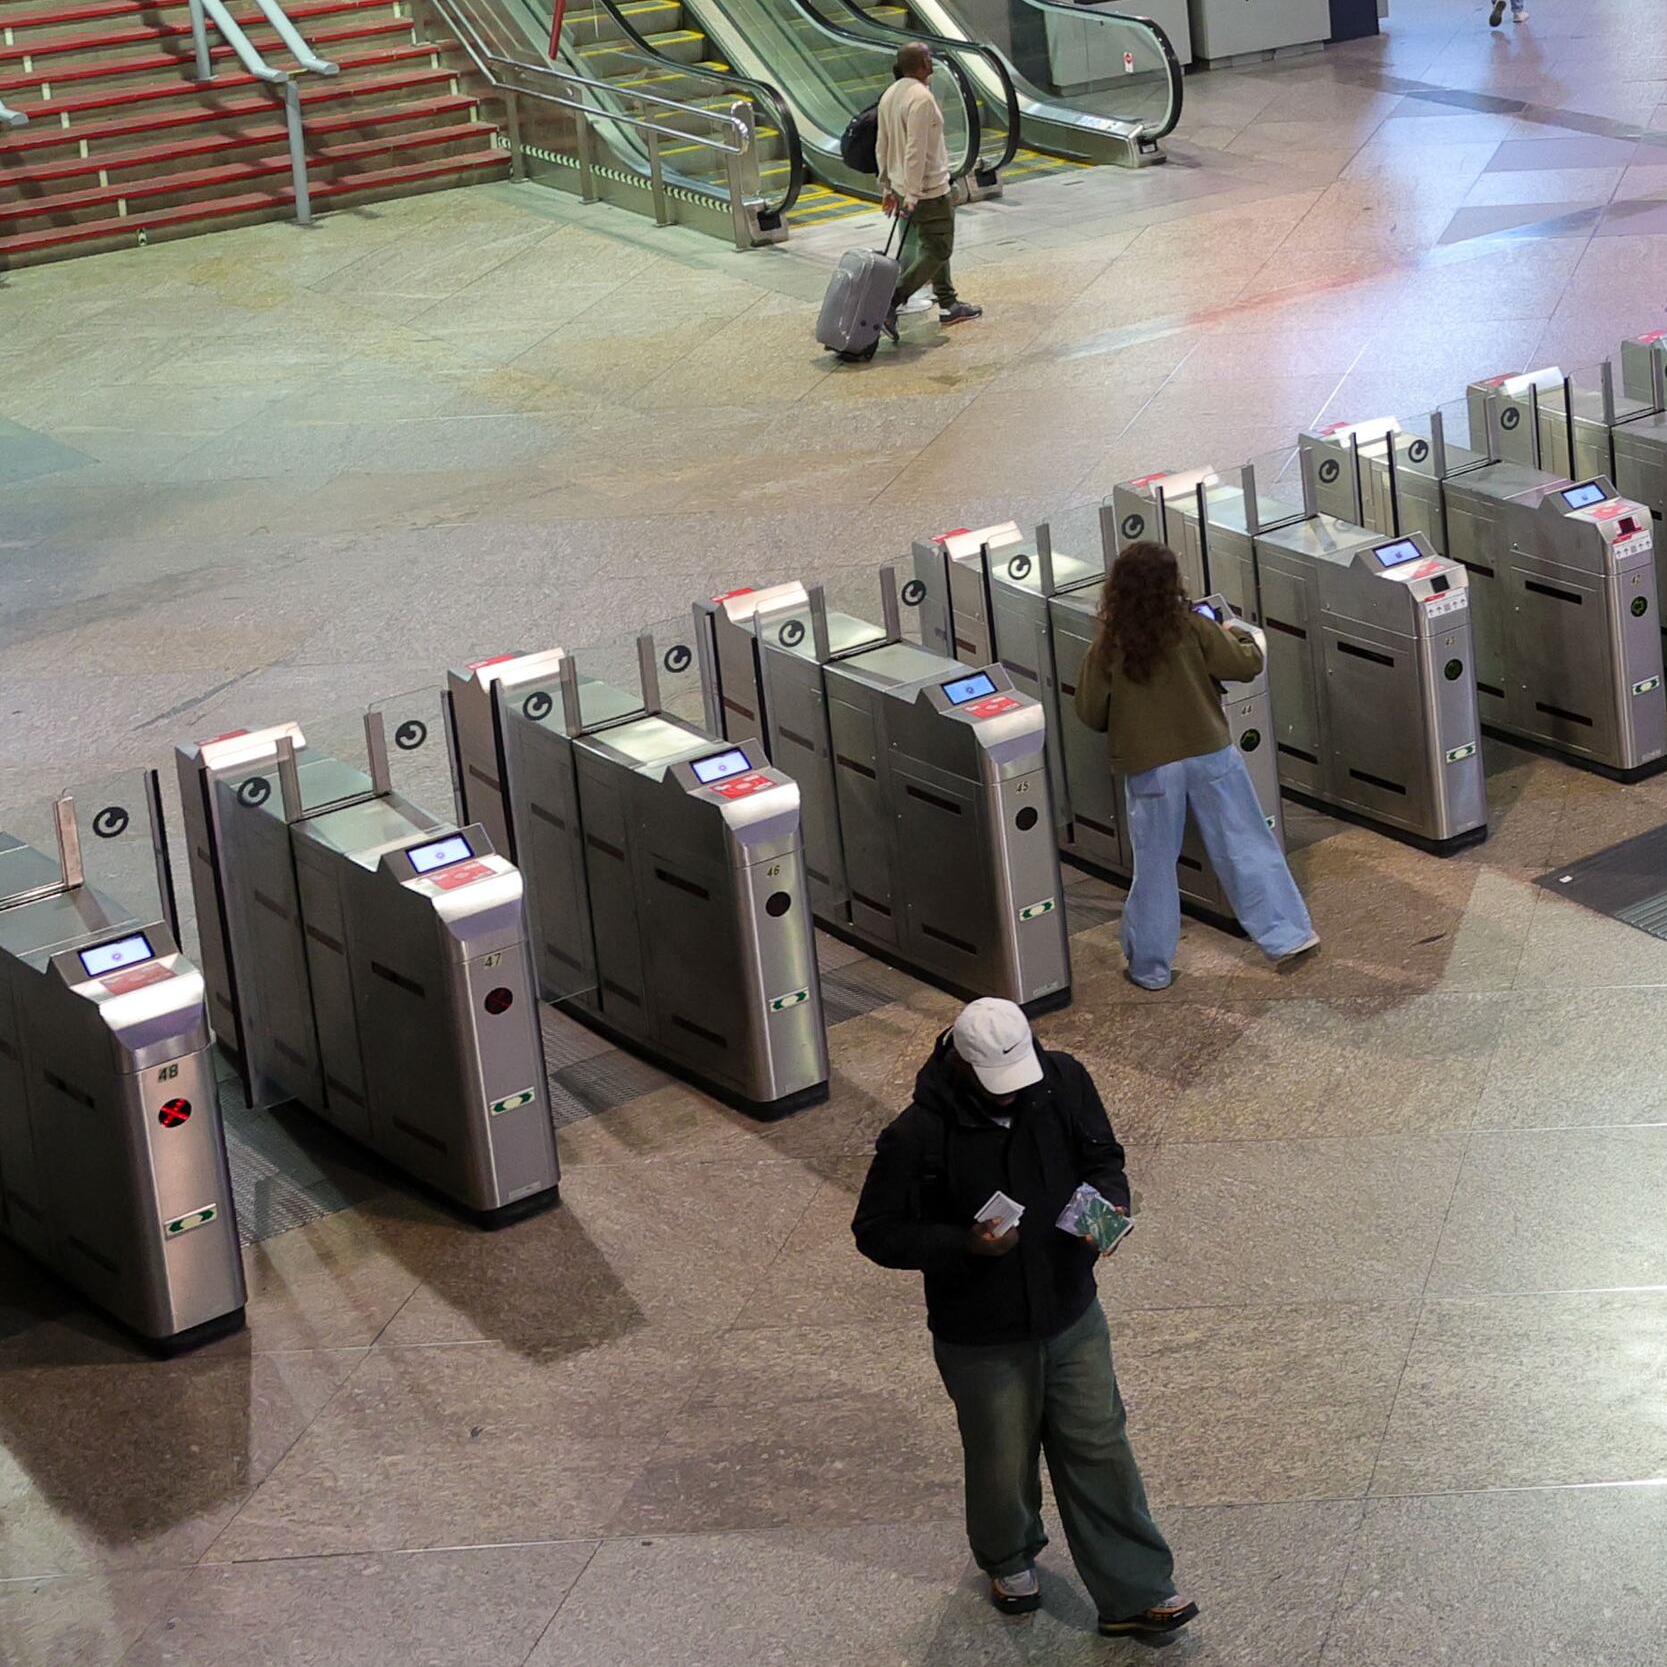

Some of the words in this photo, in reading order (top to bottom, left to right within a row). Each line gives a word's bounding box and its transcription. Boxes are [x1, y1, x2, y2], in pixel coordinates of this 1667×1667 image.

[1015, 780, 1029, 793] 45
[766, 864, 781, 877] 46
[484, 952, 502, 968] 47
[157, 1063, 179, 1083] 48
